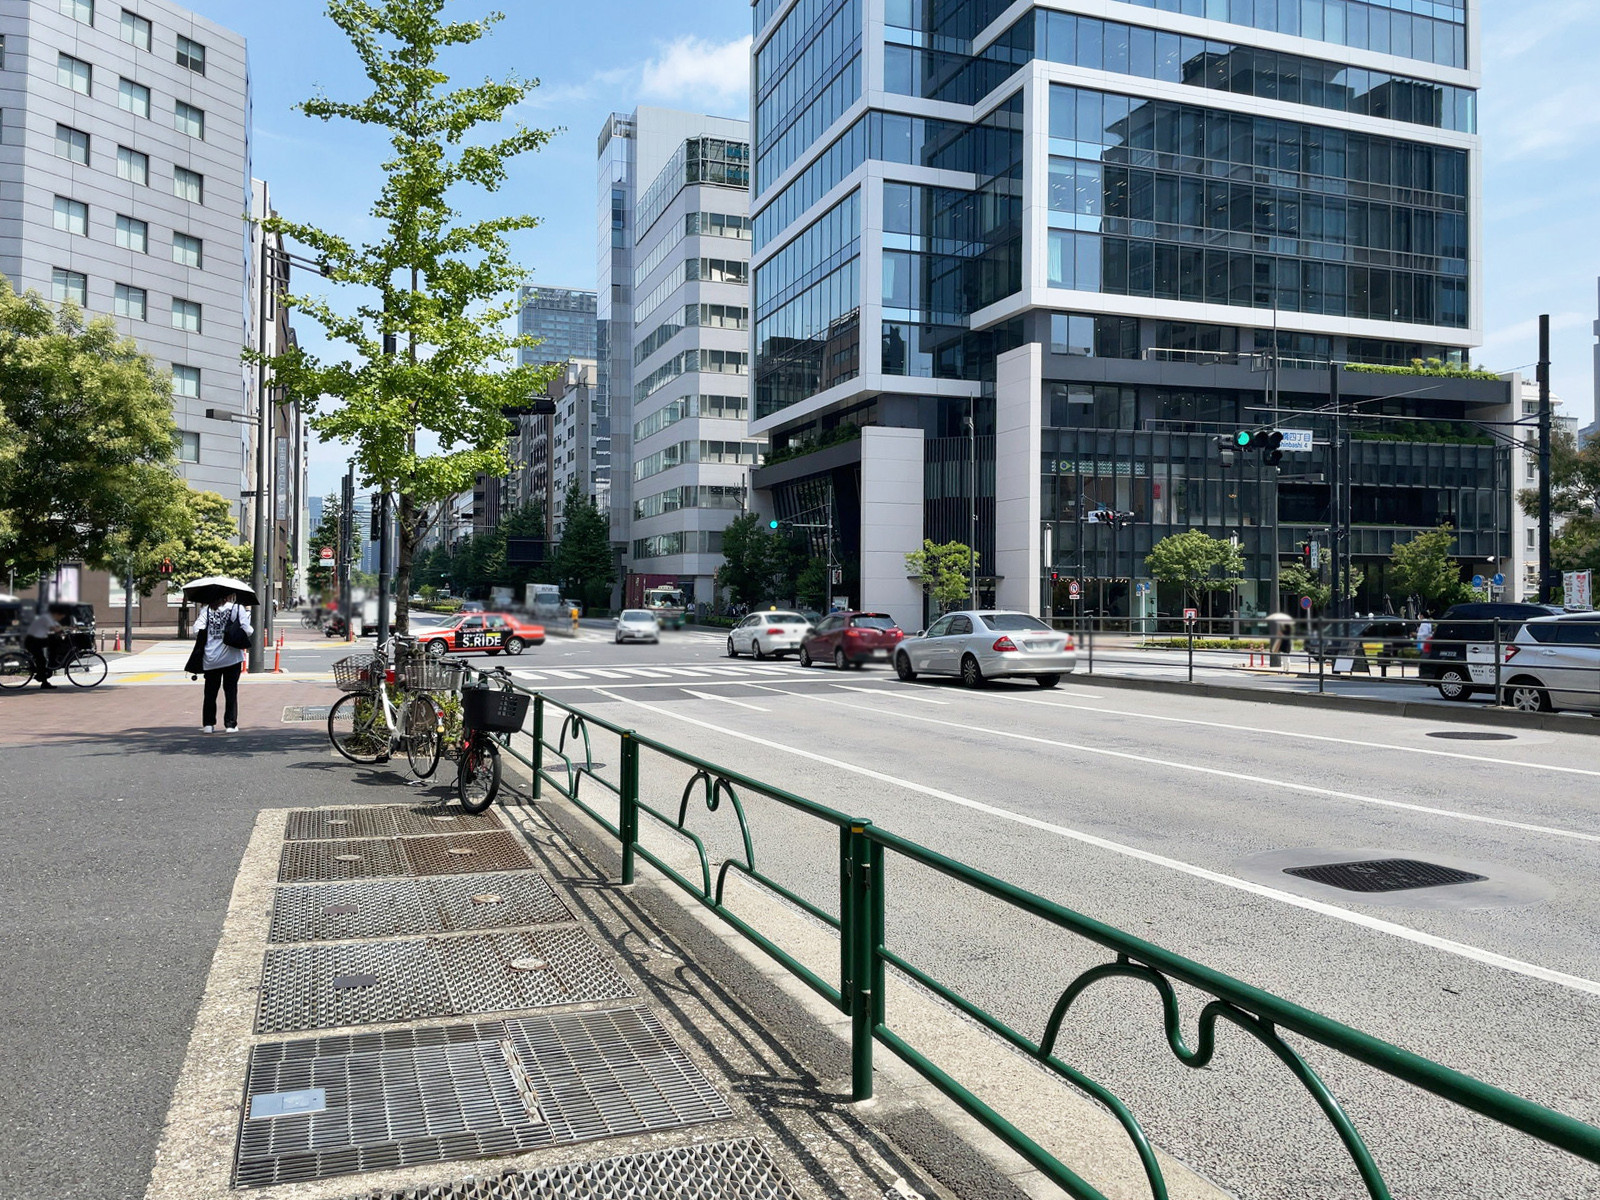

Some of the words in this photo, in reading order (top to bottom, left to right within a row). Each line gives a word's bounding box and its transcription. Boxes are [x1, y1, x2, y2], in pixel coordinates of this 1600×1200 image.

[1283, 433, 1310, 442] 橋四丁目
[462, 636, 501, 647] S.RIDE
